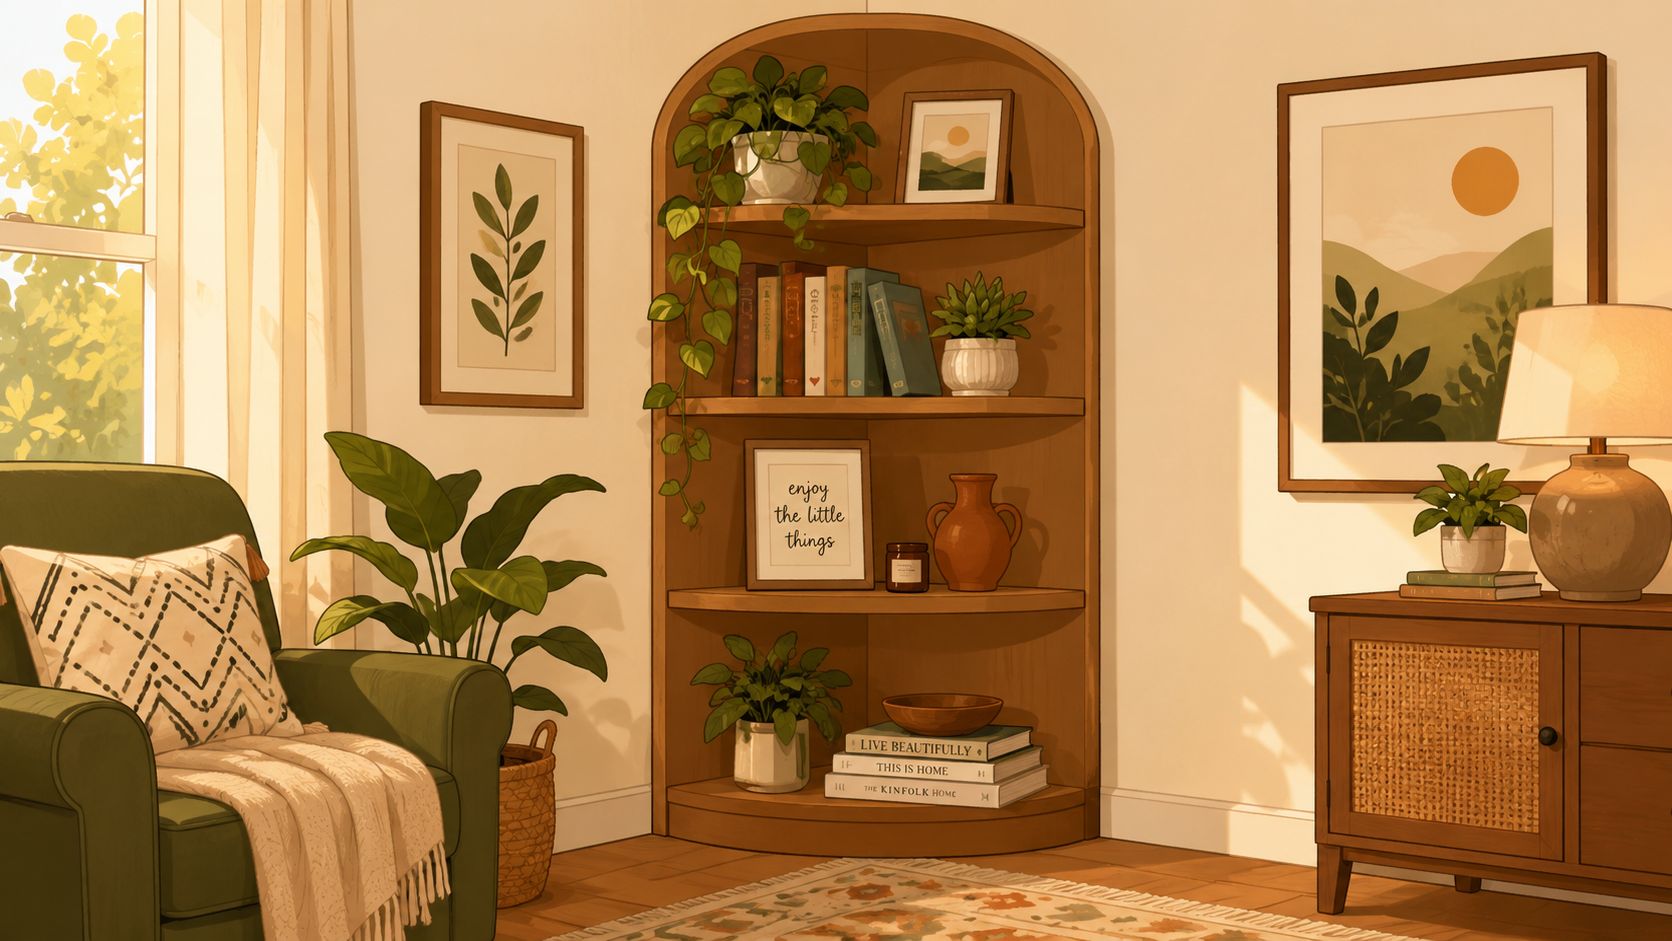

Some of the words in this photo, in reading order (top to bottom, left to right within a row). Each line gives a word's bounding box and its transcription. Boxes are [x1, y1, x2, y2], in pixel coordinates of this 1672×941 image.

[788, 480, 829, 503] enjoy
[774, 504, 802, 525] the
[807, 504, 845, 524] little
[785, 529, 835, 556] things
[860, 739, 888, 751] LIVE
[891, 741, 972, 756] BEAUTIFULLY
[876, 762, 902, 774] THIS
[904, 764, 914, 774] IS
[916, 764, 949, 776] HOME
[880, 785, 929, 797] KINFOLK
